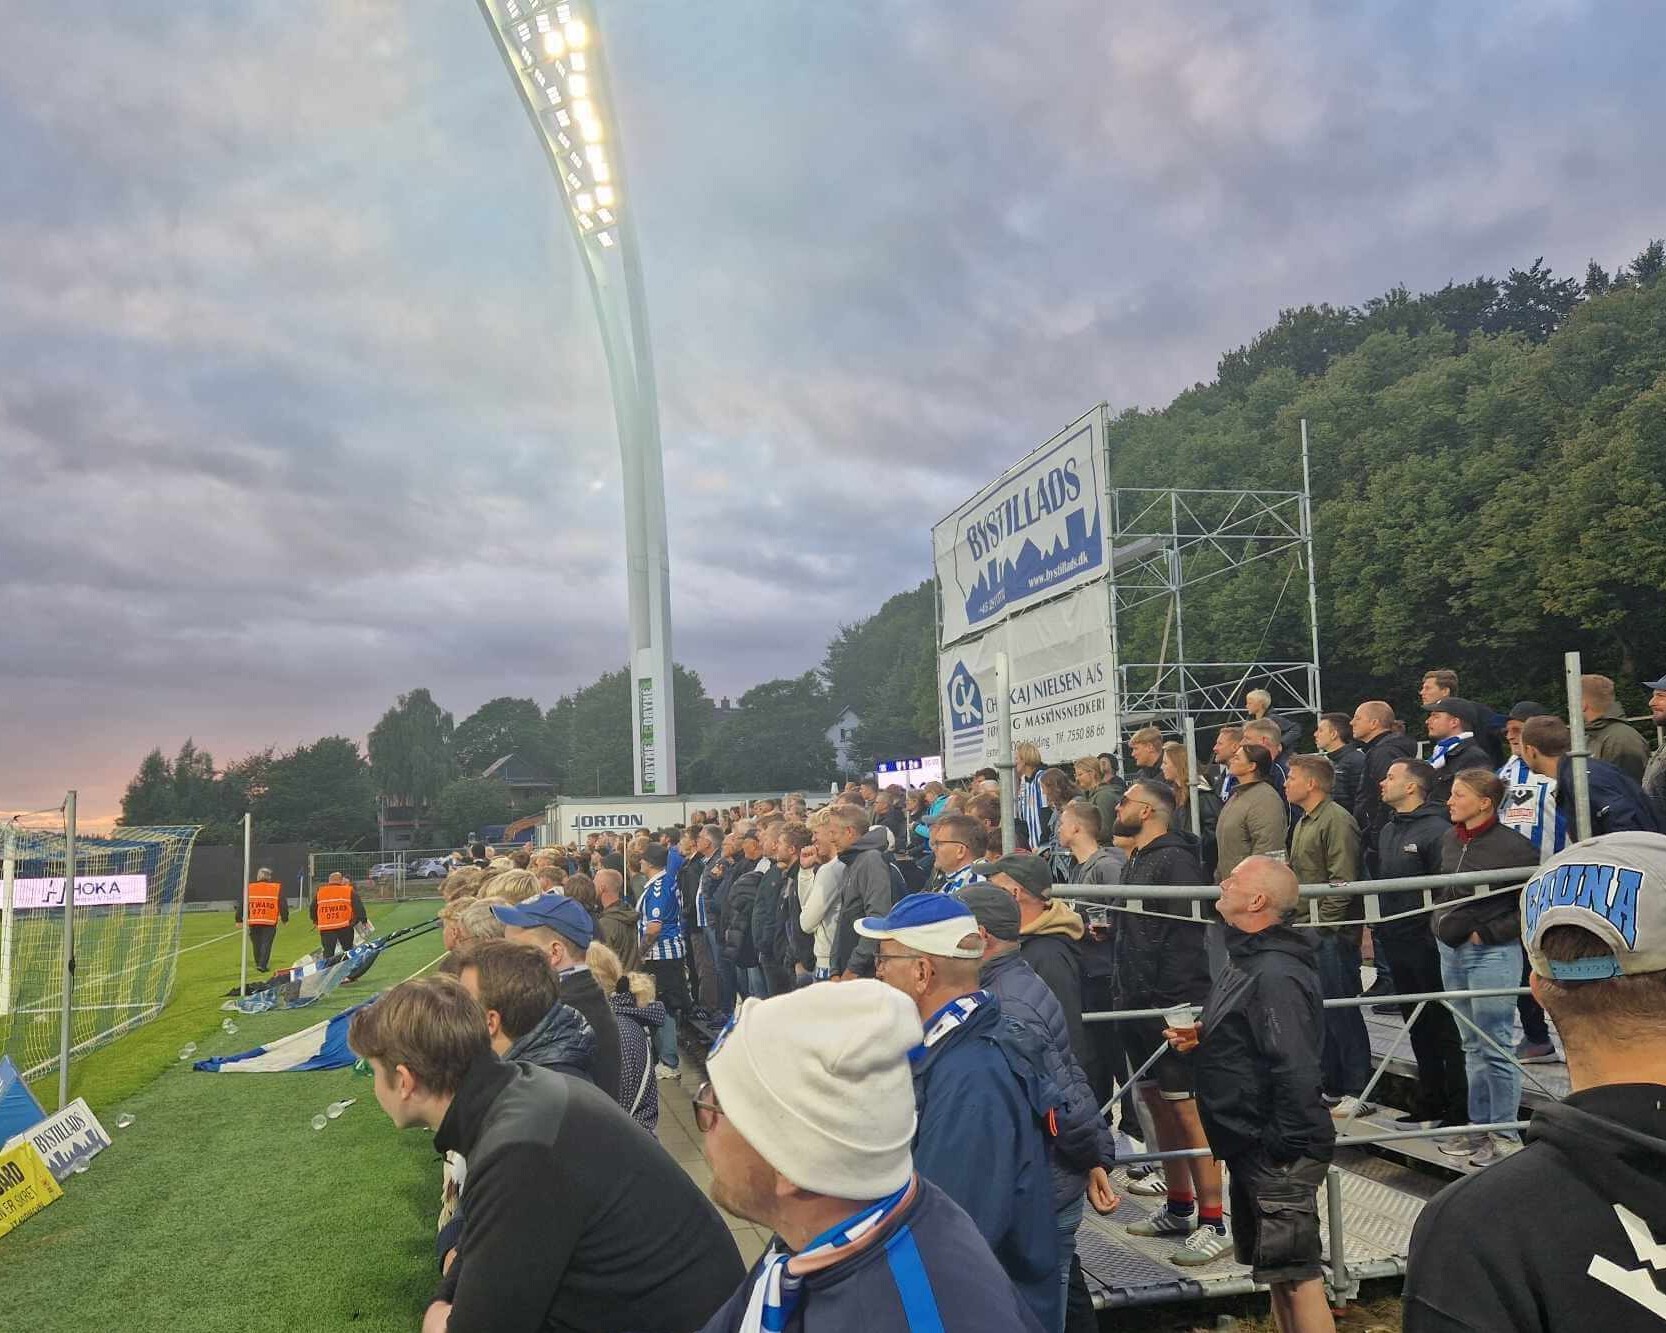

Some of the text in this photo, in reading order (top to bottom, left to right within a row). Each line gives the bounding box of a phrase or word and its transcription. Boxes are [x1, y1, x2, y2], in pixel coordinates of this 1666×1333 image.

[966, 457, 1081, 562] BYSTILLADS
[1034, 670, 1082, 699] NIELSEN
[1086, 662, 1103, 686] A/S
[1025, 697, 1105, 728] MASKINSNEDKERI
[571, 814, 643, 828] JORTON
[33, 1112, 86, 1154] BYSTILLADS
